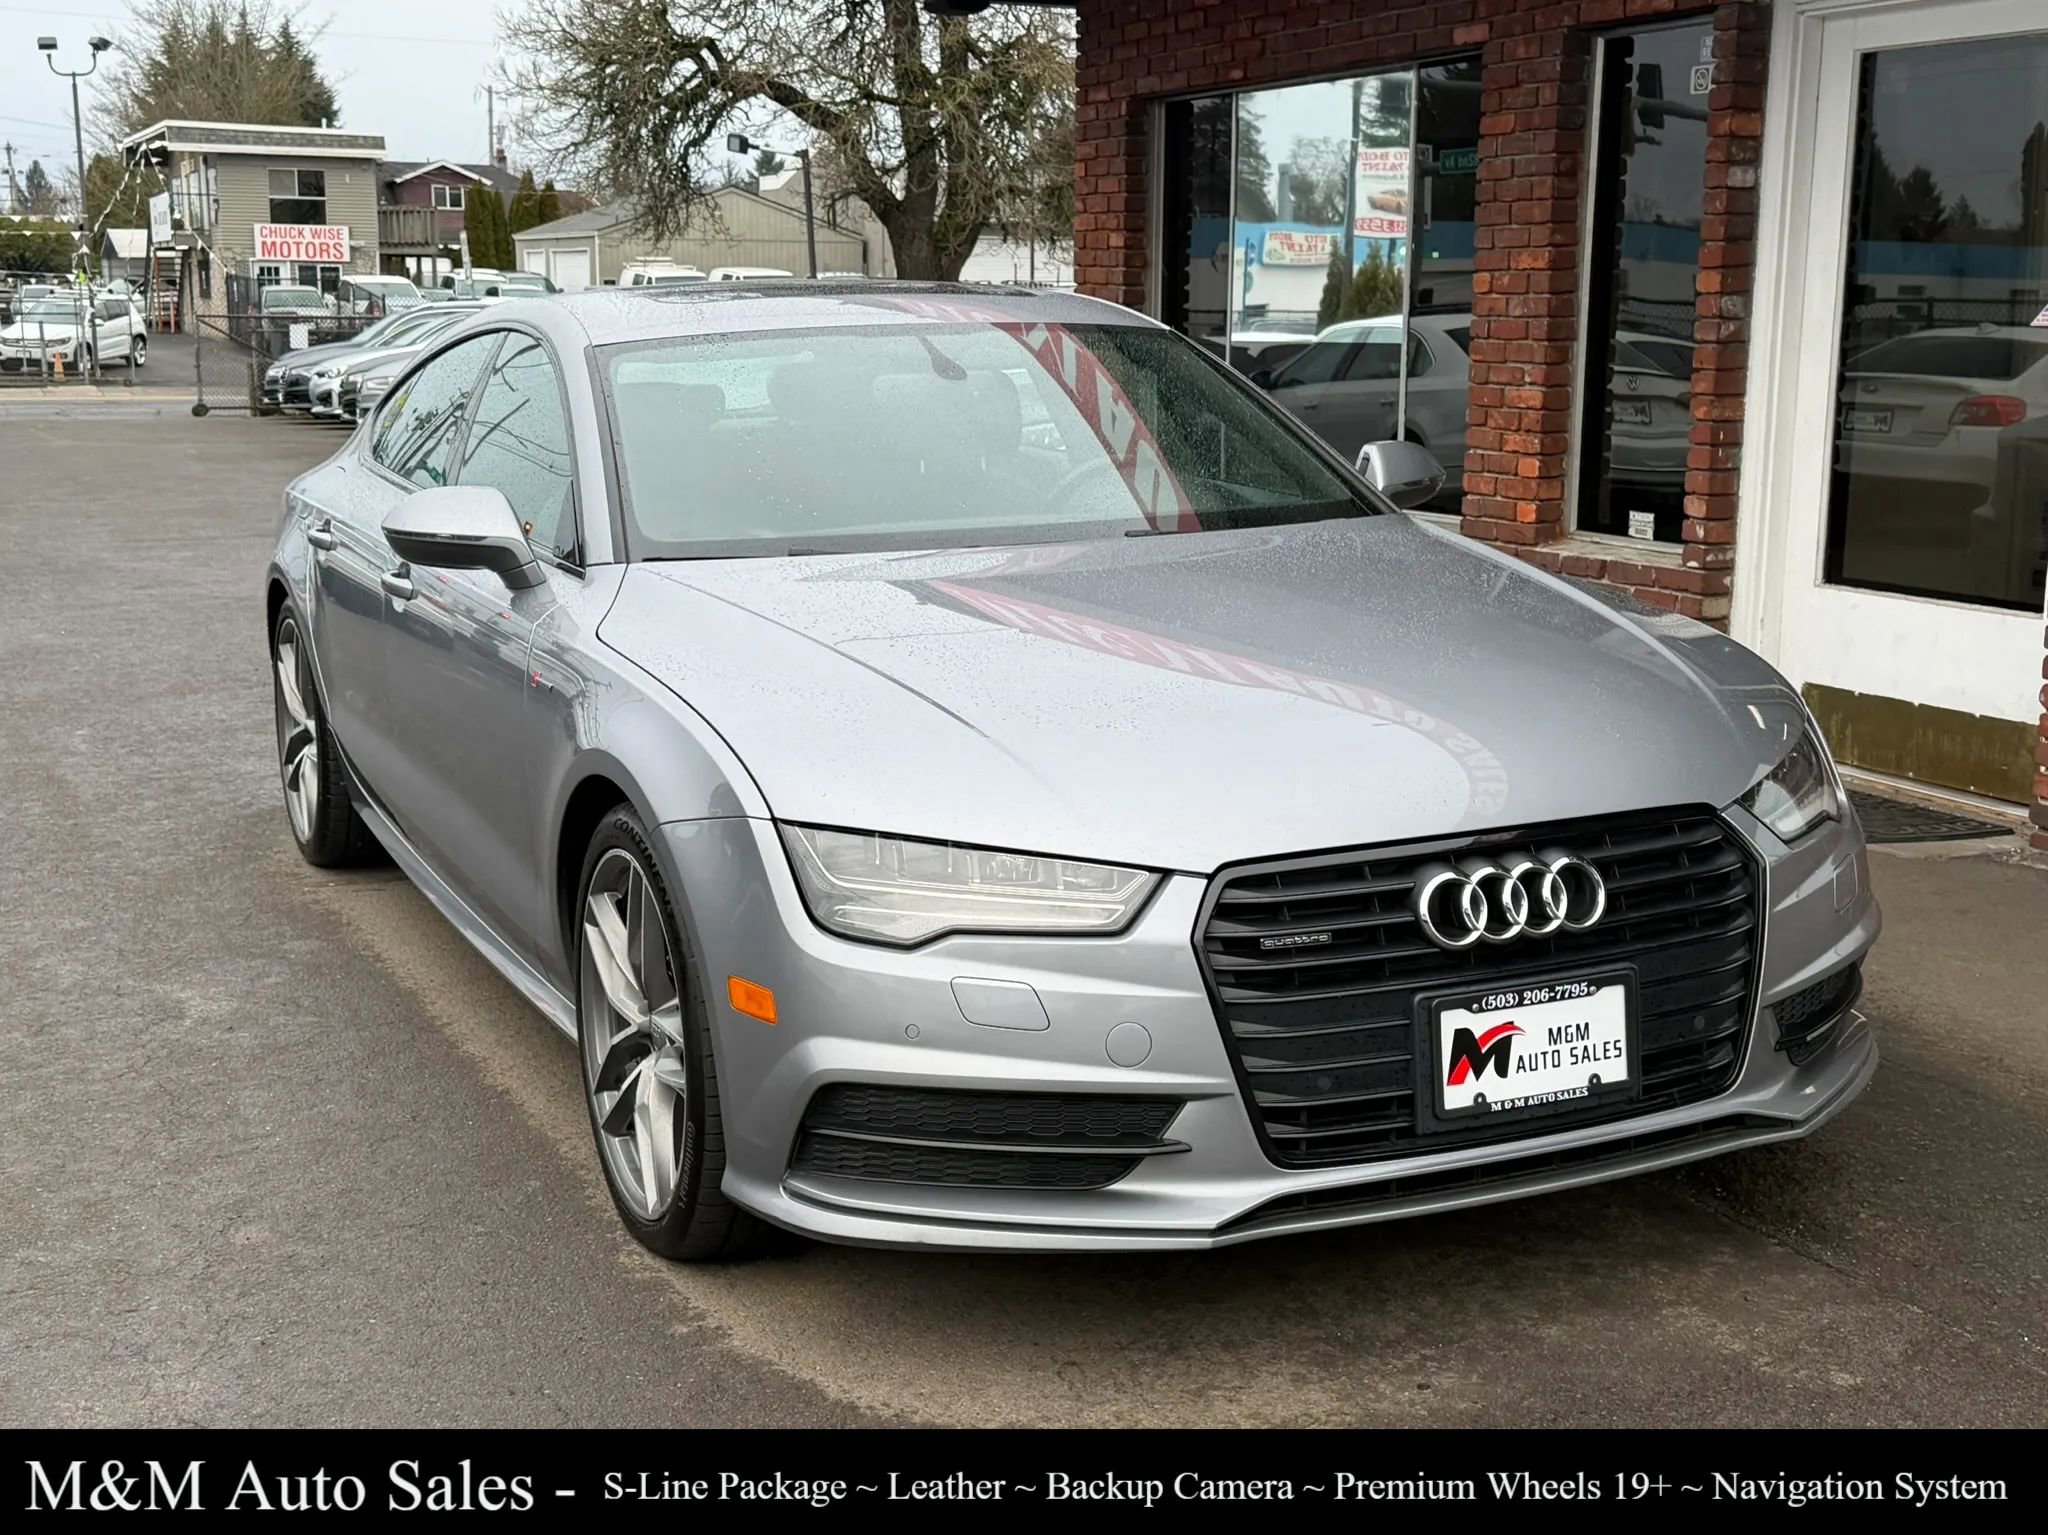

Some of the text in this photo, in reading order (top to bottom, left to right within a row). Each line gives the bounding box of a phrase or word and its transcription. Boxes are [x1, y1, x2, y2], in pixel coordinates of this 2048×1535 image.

[260, 226, 344, 240] CHUCK WISE
[261, 240, 344, 260] MOTORS
[1263, 933, 1329, 948] quattro
[1482, 982, 1588, 1010] (503) 206-7795
[1548, 1022, 1590, 1047] M&M
[1516, 1039, 1622, 1074] AUTO SALES
[1527, 1093, 1556, 1107] AUTO
[1557, 1087, 1588, 1101] SALES
